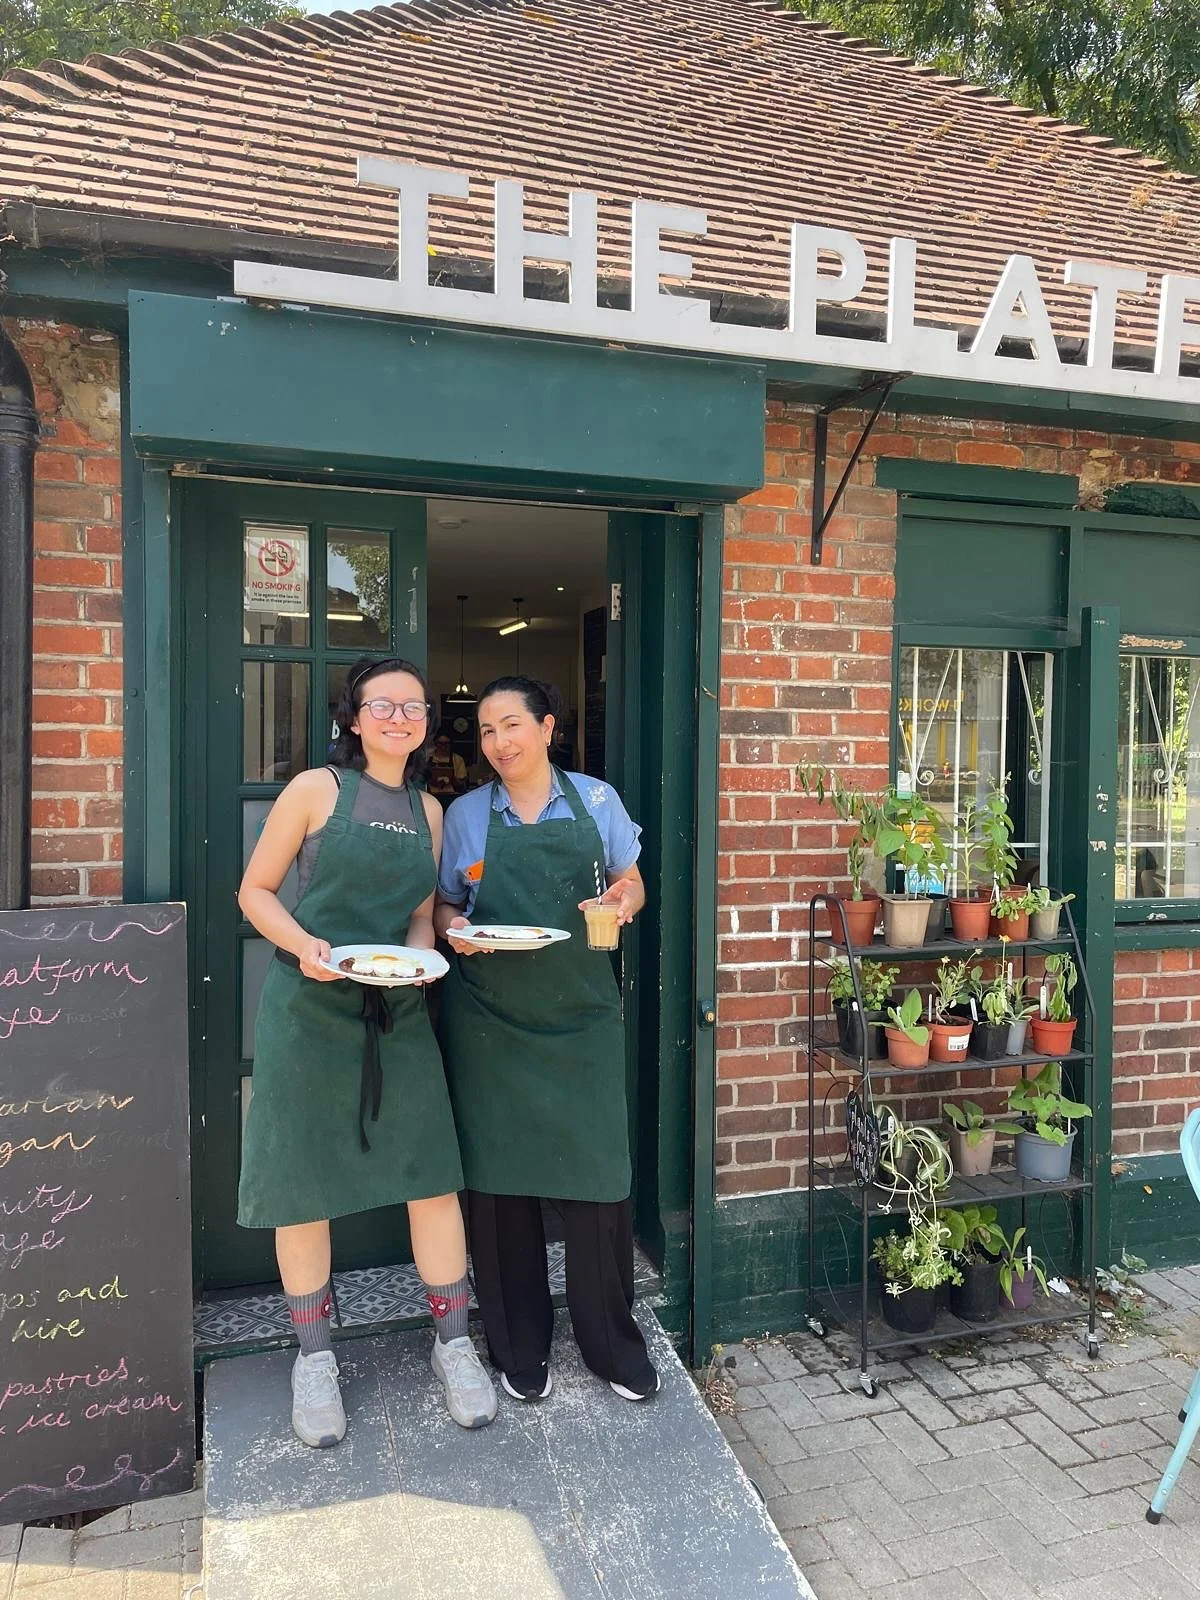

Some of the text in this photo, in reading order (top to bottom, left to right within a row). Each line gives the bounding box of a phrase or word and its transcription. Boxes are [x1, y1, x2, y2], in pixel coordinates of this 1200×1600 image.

[356, 155, 711, 325] THE
[252, 581, 264, 589] NO
[57, 1275, 129, 1303] and
[11, 1317, 86, 1342] hire
[16, 1391, 184, 1434] ice cream
